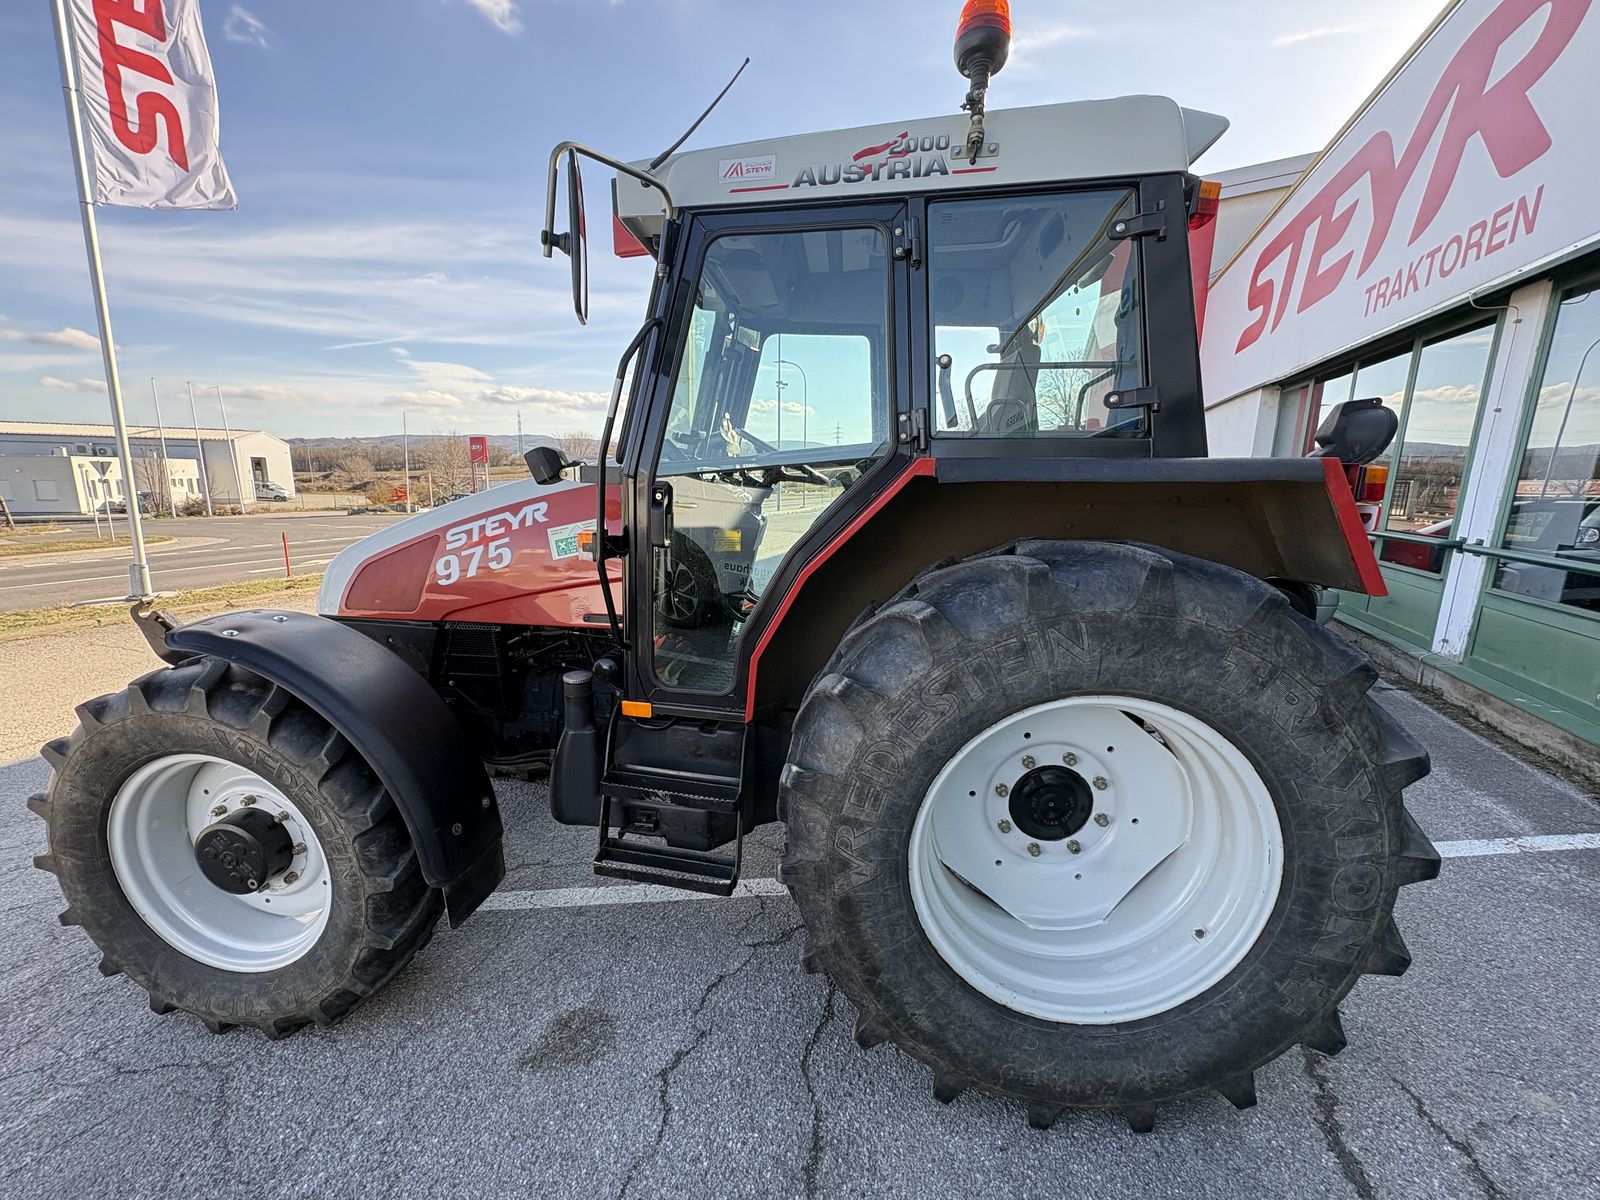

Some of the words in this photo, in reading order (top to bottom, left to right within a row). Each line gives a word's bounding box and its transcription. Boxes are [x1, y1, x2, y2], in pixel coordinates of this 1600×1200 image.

[889, 134, 950, 155] 2000
[745, 166, 772, 174] STEYR
[791, 154, 949, 187] AUSTRIA
[1235, 0, 1592, 355] STEYR
[1364, 184, 1545, 318] TRAKTOREN
[445, 501, 549, 550] STEYR
[435, 537, 512, 586] 975
[833, 620, 1092, 897] VREDESTEIN
